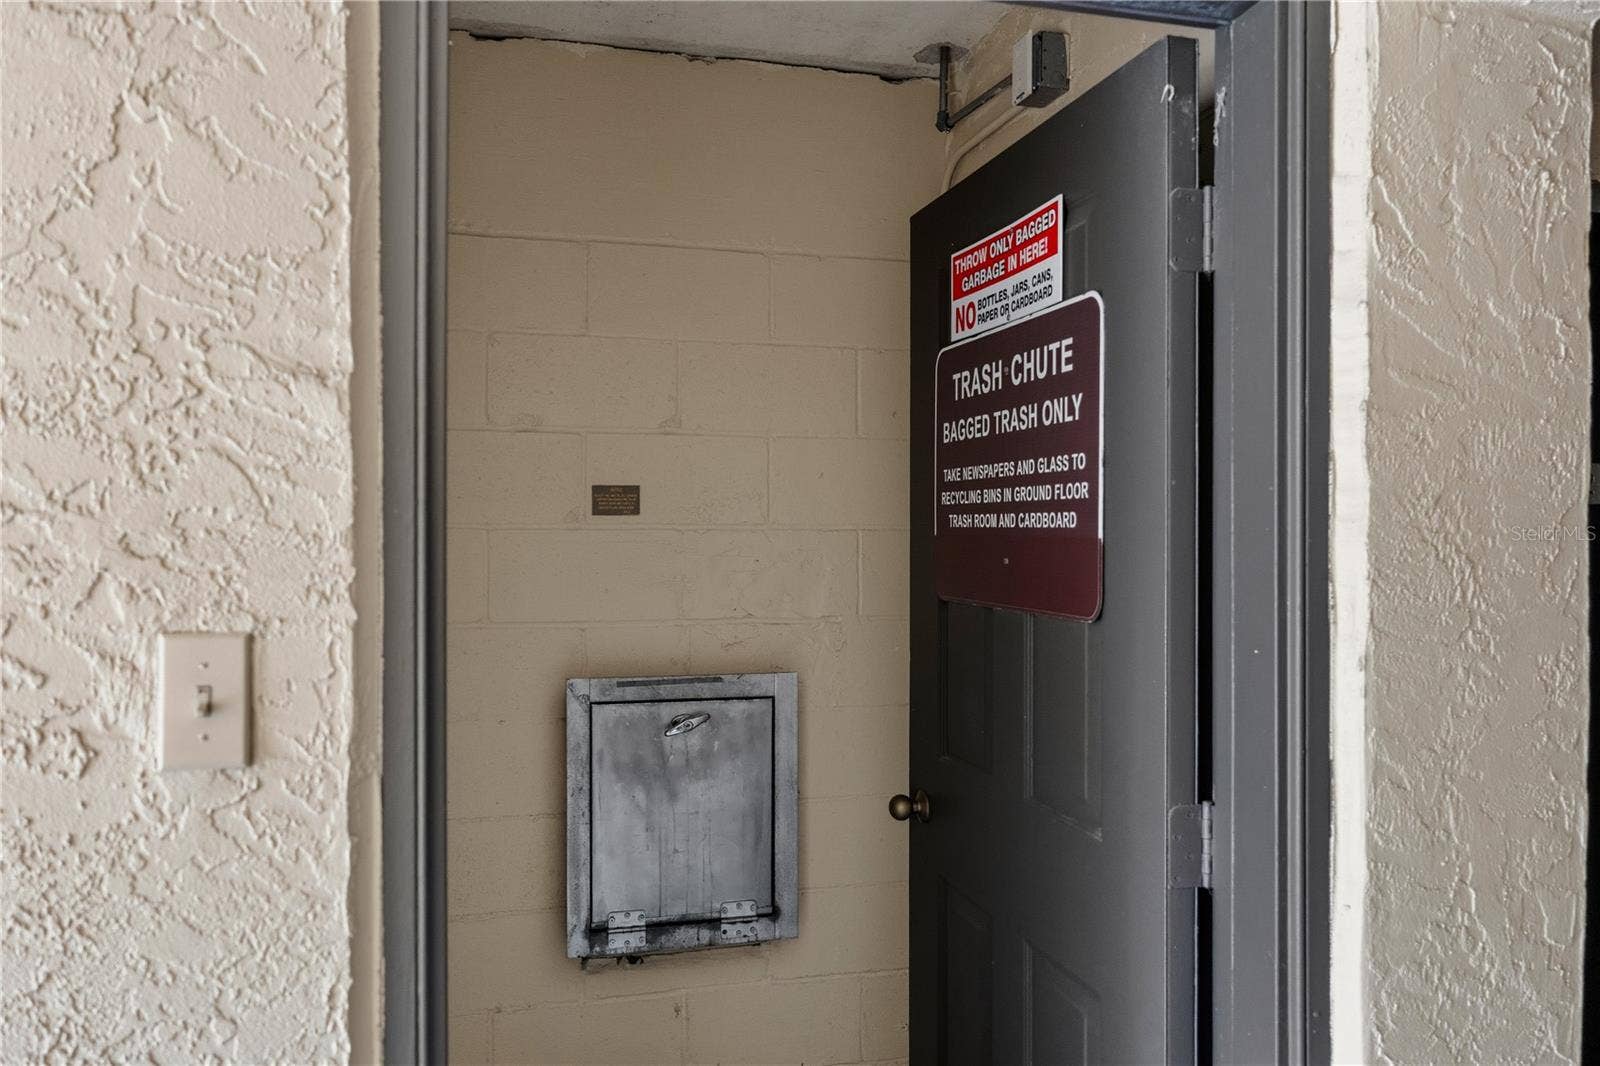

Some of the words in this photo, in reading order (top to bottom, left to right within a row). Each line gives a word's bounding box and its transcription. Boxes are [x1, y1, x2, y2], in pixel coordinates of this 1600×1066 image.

[954, 246, 988, 275] THROW
[989, 232, 1014, 258] ONLY
[1016, 209, 1056, 246] BAGGED
[961, 259, 1005, 292] GARBAGE
[1007, 253, 1017, 273] IN
[1020, 236, 1048, 266] HERE!
[977, 288, 1009, 311] BOTTLES,
[1011, 279, 1030, 297] JARS,
[1031, 268, 1053, 288] CANS,
[977, 308, 998, 325] PAPER
[1000, 303, 1009, 317] OR
[1011, 284, 1053, 313] CARDBOARD
[955, 301, 976, 334] NO
[952, 359, 1002, 401] TRASH
[1011, 336, 1074, 386] CHUTE
[943, 414, 990, 444] BAGGED
[993, 402, 1038, 435] TRASH
[1042, 392, 1083, 426] ONLY
[943, 467, 961, 483] TAKE
[962, 461, 1015, 481] NEWSPAPERS
[1016, 459, 1035, 476] AND
[1037, 454, 1069, 474] GLASS
[1071, 452, 1086, 470] TO
[941, 490, 981, 505] RECYCLING
[983, 488, 1002, 503] BINS
[1003, 487, 1012, 502] IN
[1014, 485, 1052, 501] GROUND
[1054, 481, 1089, 500] FLOOR
[949, 513, 973, 528] TRASH
[974, 513, 997, 528] ROOM
[998, 513, 1016, 528] AND
[1018, 511, 1077, 528] CARDBOARD
